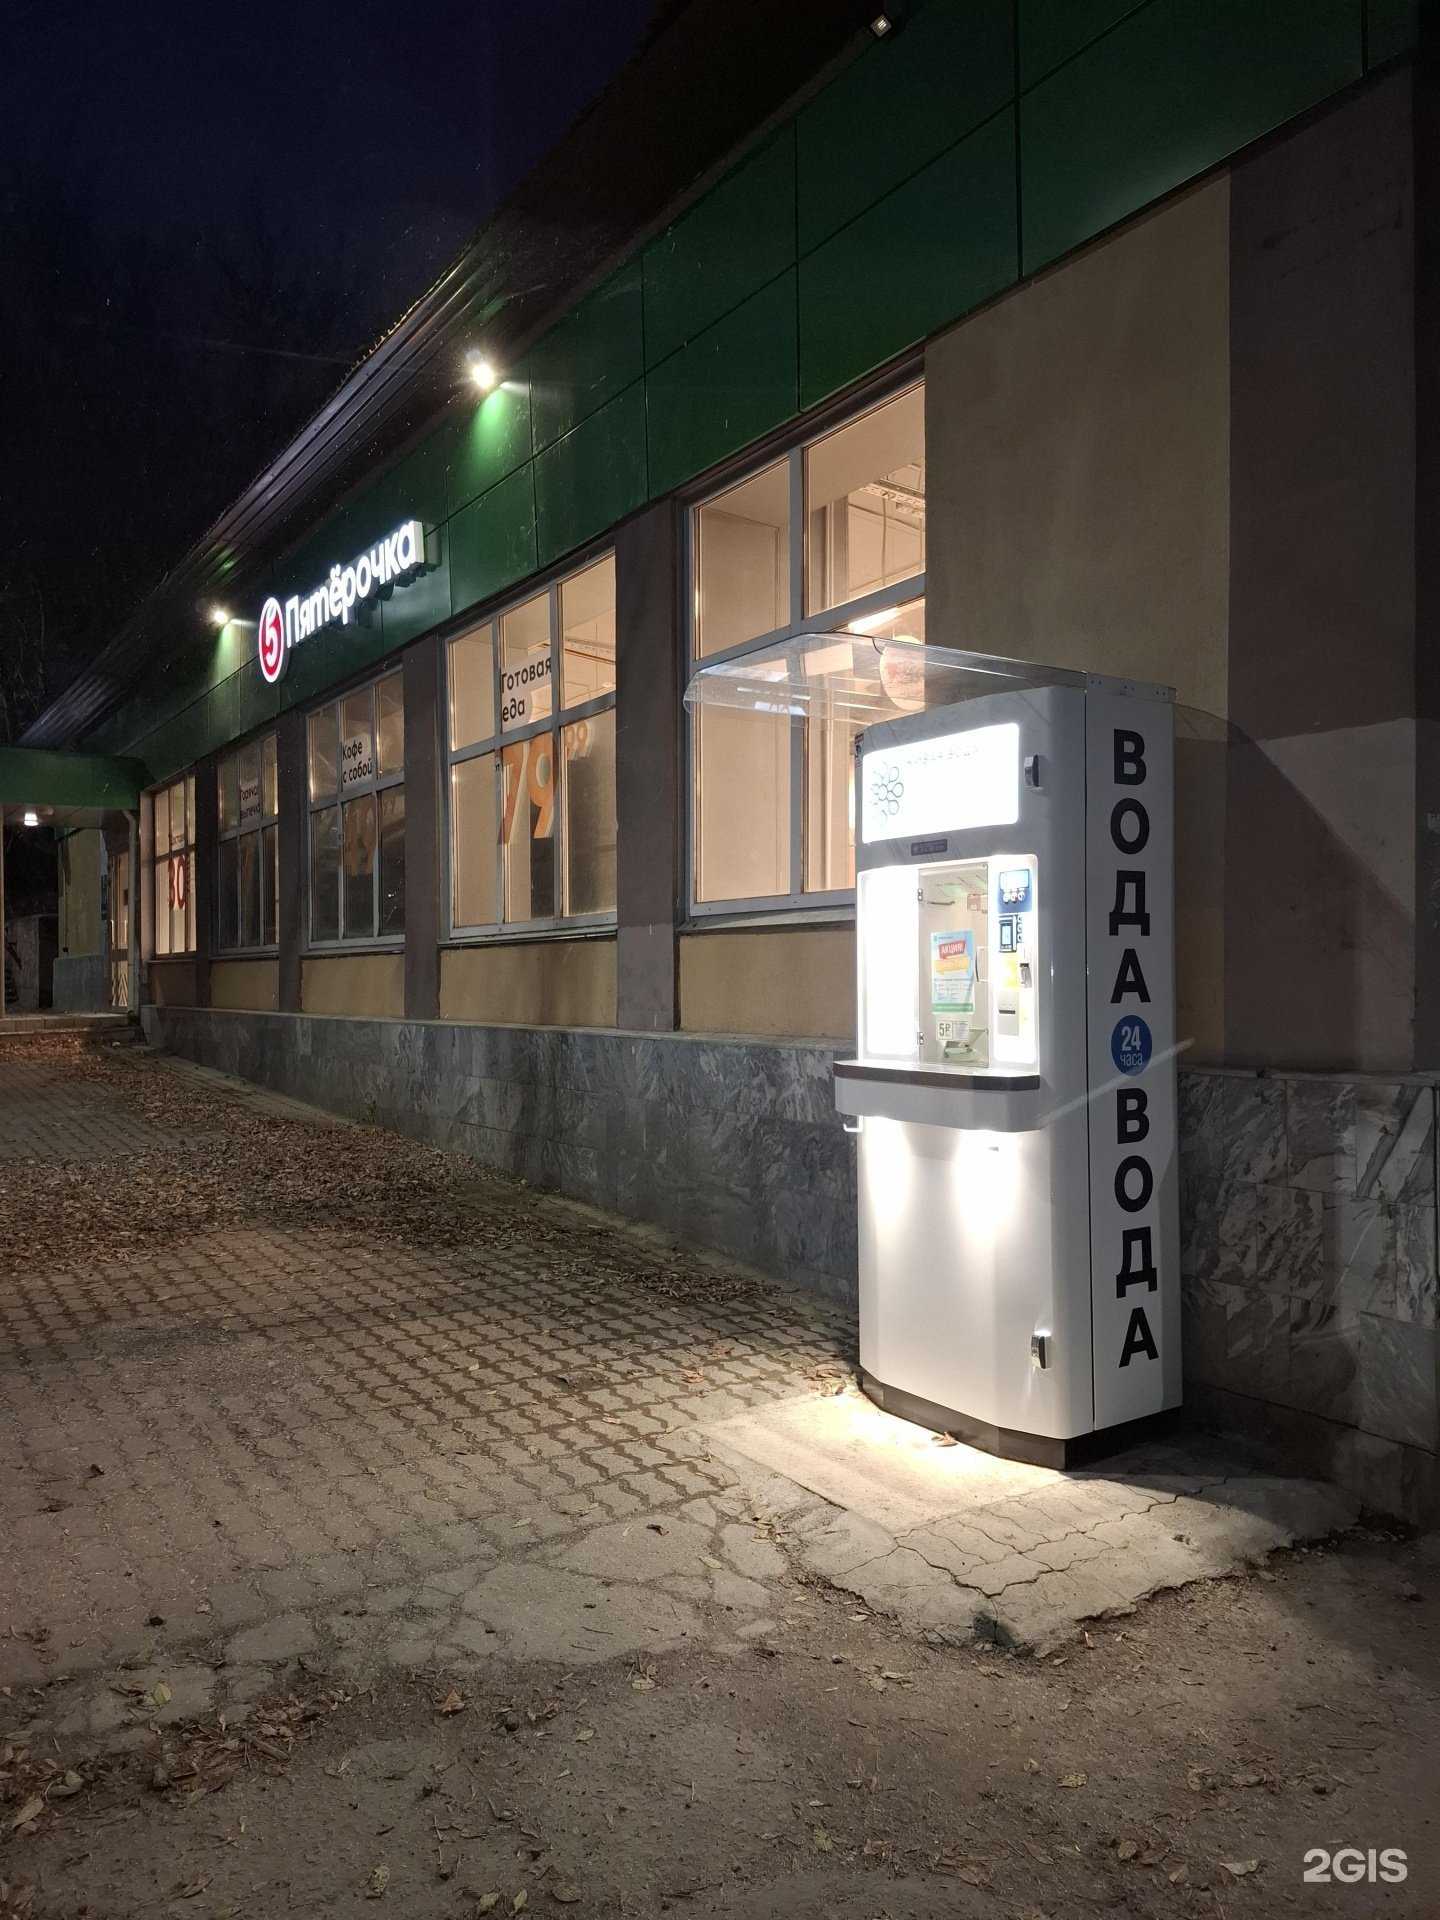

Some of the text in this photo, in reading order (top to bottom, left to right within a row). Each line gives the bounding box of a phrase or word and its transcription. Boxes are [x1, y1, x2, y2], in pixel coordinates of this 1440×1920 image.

[286, 520, 418, 648] Пятёрочка
[501, 656, 551, 693] Готовая
[502, 697, 526, 722] еда
[342, 740, 363, 761] Кофе
[343, 758, 373, 783] с собой
[1108, 728, 1152, 1004] ВОДА
[1121, 1025, 1142, 1050] 24
[1120, 1052, 1143, 1066] часа
[1114, 1088, 1159, 1368] ВОДА
